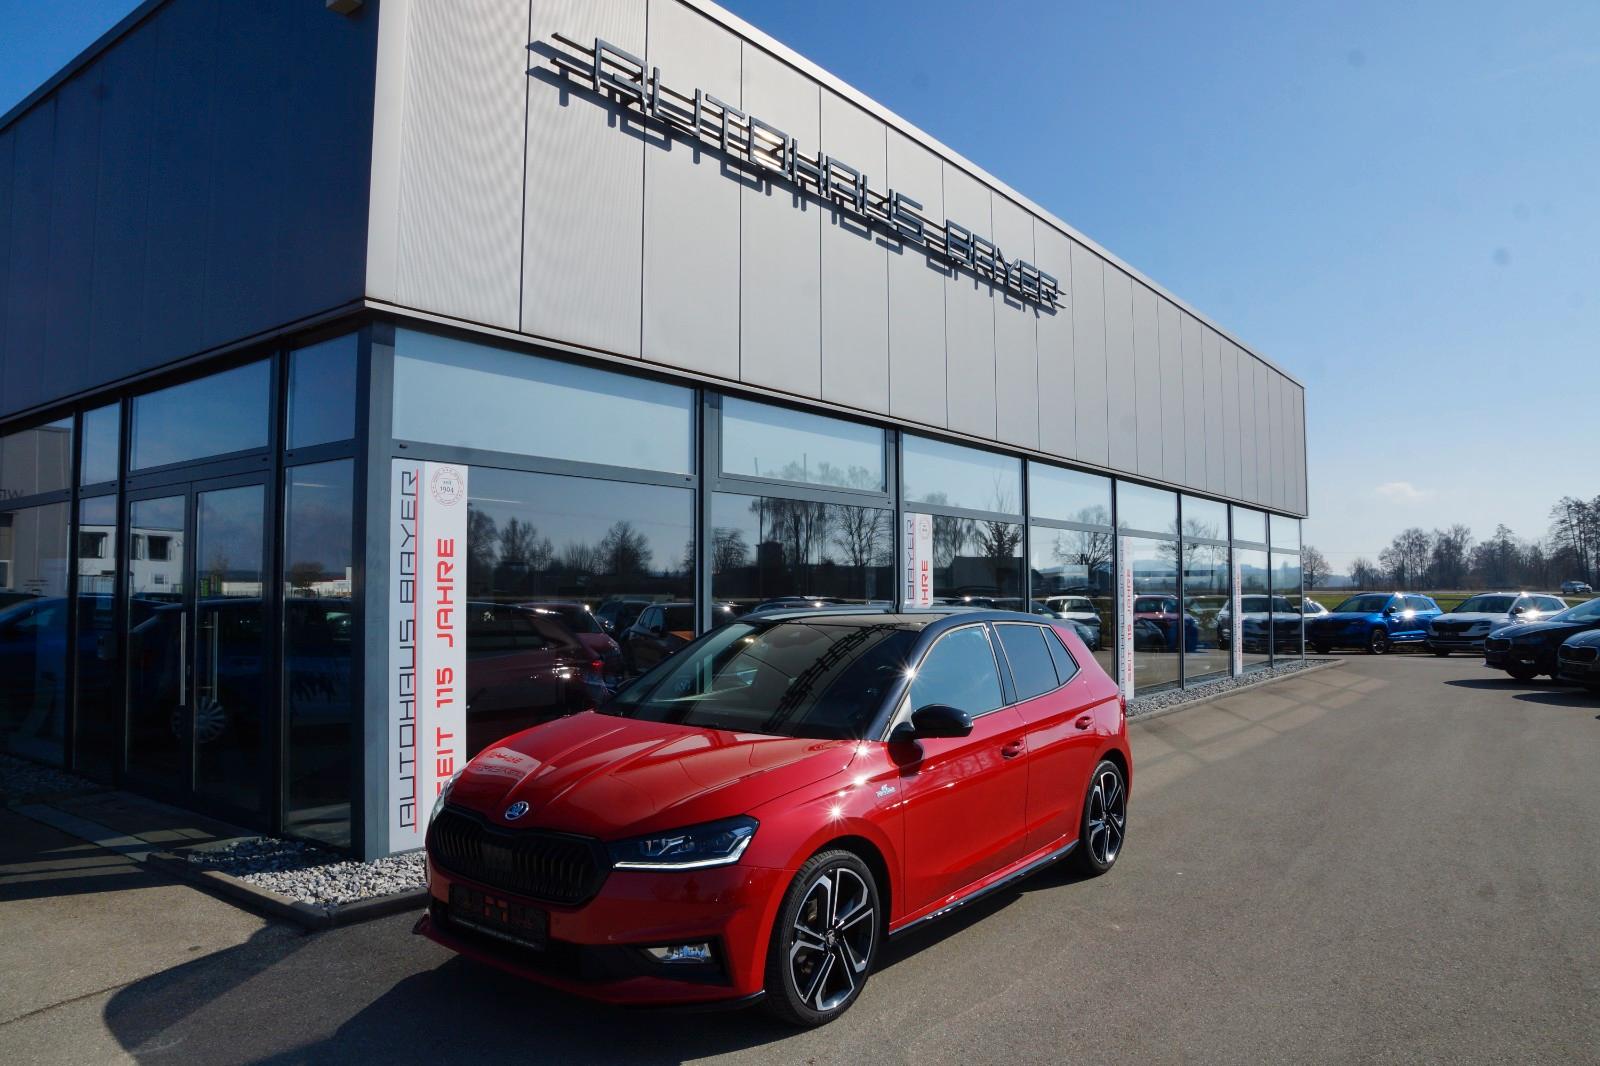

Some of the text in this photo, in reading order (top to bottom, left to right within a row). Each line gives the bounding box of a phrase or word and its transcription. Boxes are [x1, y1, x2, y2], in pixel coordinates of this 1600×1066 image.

[593, 36, 1060, 309] AUTOHAUS BAYER
[436, 538, 455, 648] JAHRE
[907, 519, 915, 600] BAYER
[399, 470, 417, 828] AUTOHAUS BAYER
[436, 667, 454, 708] 115
